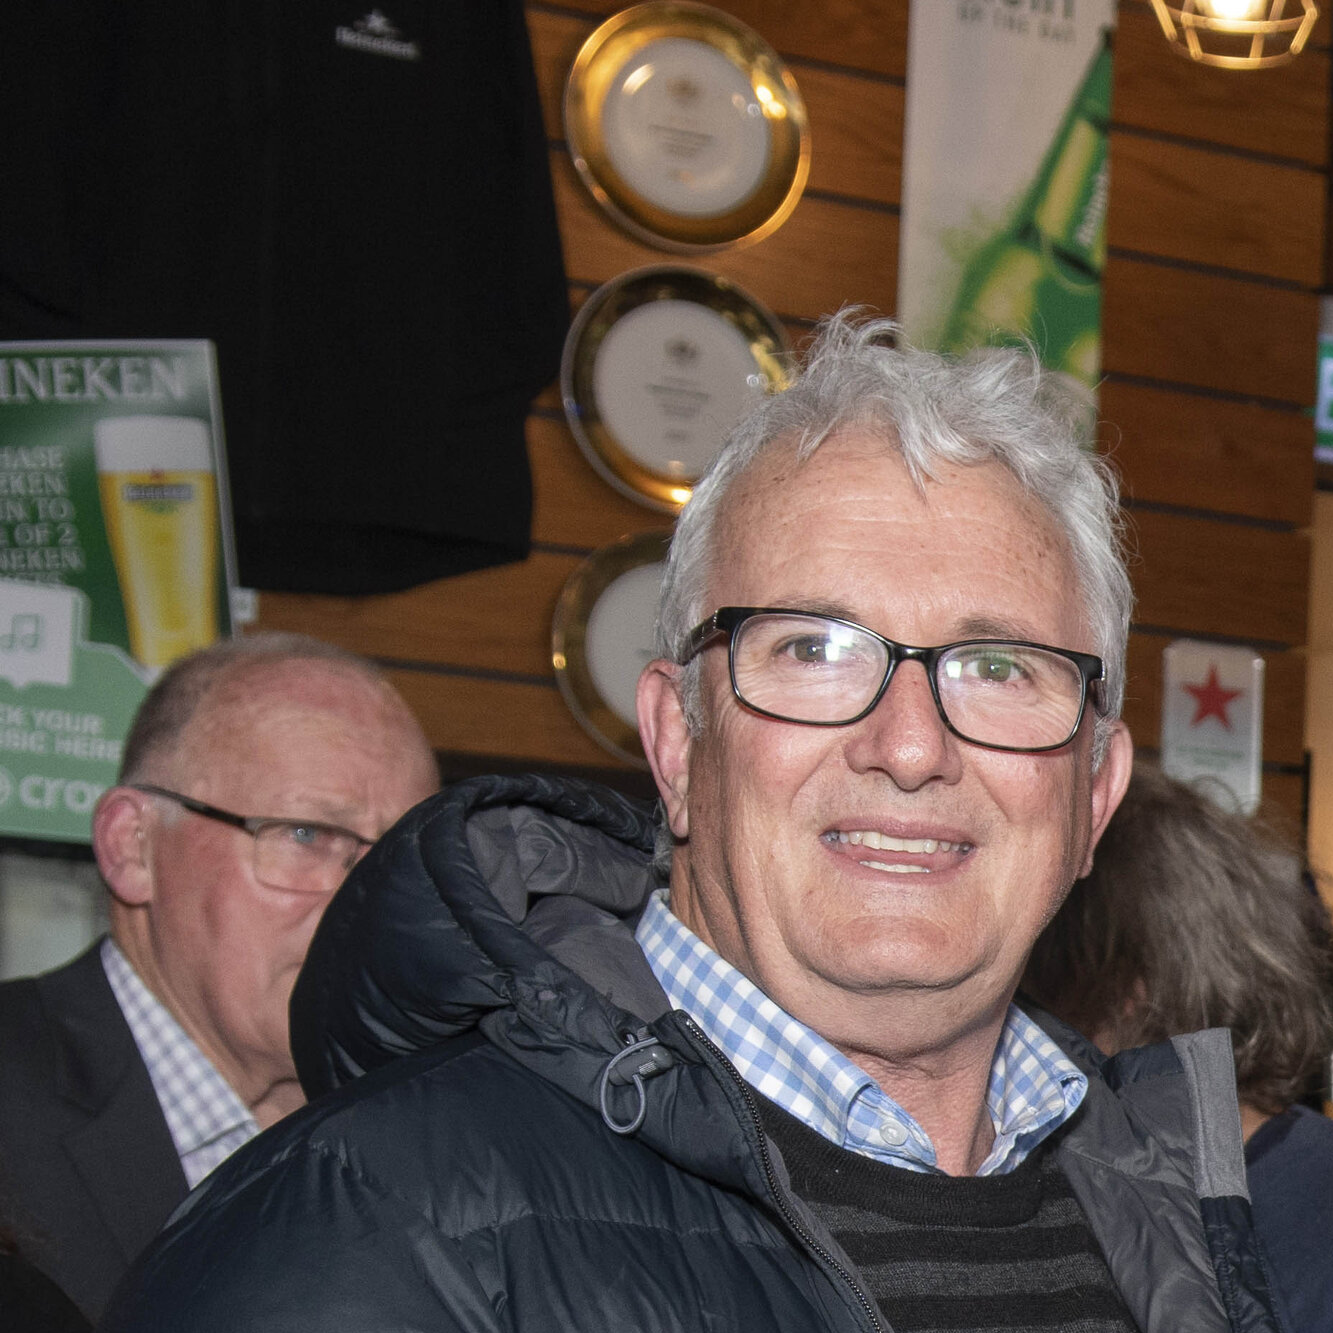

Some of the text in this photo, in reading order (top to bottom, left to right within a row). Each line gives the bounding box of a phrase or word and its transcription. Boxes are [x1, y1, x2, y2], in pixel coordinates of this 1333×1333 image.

[14, 523, 52, 546] OF
[32, 708, 104, 735] YOUR
[18, 774, 107, 814] cro
